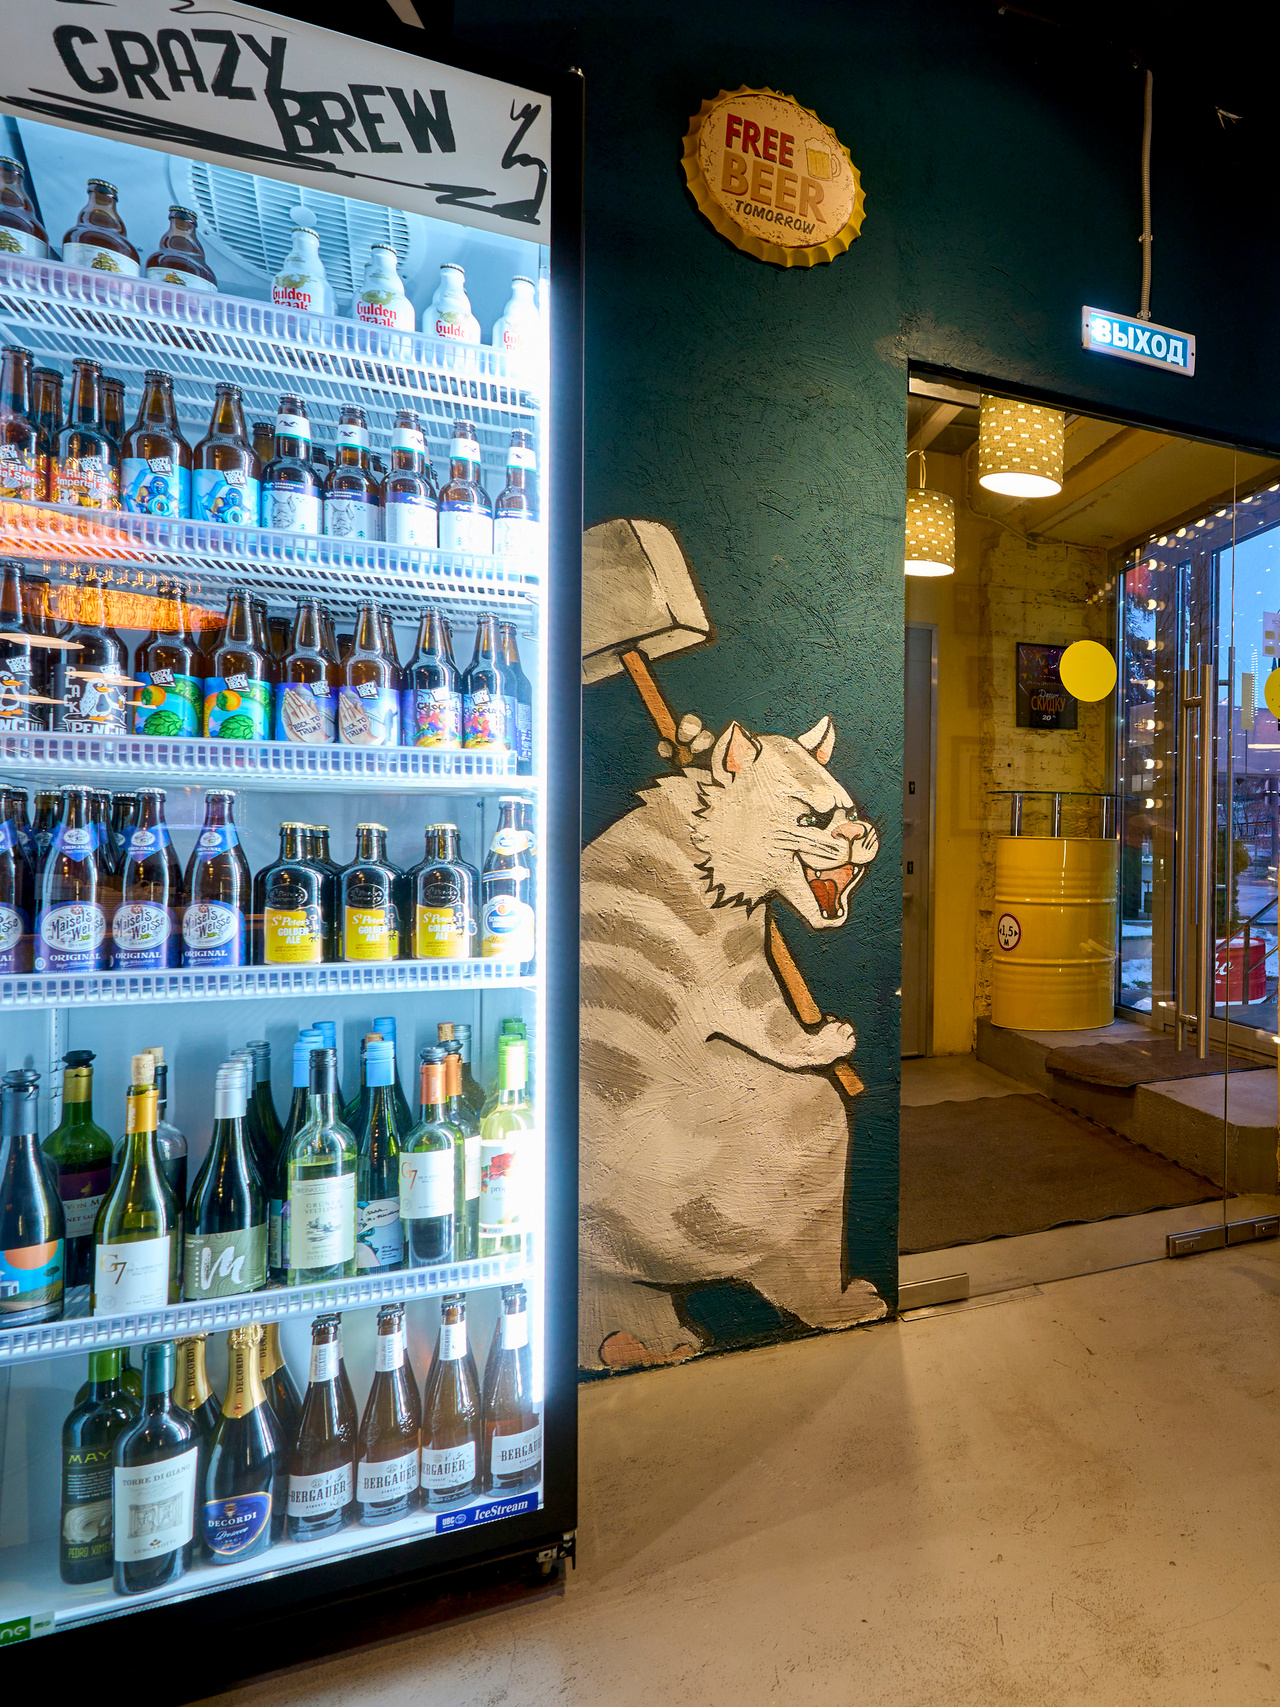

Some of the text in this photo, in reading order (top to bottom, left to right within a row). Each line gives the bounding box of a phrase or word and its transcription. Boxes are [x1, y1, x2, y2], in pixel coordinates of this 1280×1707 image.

[52, 24, 287, 101] CRAZY
[267, 84, 456, 155] BREW
[725, 113, 795, 169] FREE
[721, 150, 827, 224] BEER
[735, 199, 816, 235] TOMORROW
[273, 286, 311, 303] Gulden
[357, 301, 397, 320] Gulden
[1095, 318, 1184, 366] ВЫХОД
[1031, 696, 1066, 714] СКИДКУ
[48, 906, 93, 940] Maisel's
[71, 917, 104, 941] Weisse
[131, 916, 164, 940] Weisse
[199, 915, 231, 938] Weisse
[277, 927, 309, 936] GOLDEN
[358, 926, 388, 934] GOLDEN
[1002, 925, 1013, 938] 1,5
[286, 936, 301, 944] ALE
[435, 932, 448, 940] ALE
[50, 953, 101, 961] ORIGINAL
[115, 951, 162, 959] ORIGINAL
[184, 949, 228, 957] ORIGINAL
[187, 1347, 195, 1387] DECORDI
[122, 1463, 191, 1486] TORRE DI GIANO
[364, 1465, 417, 1489] BERGAUER
[421, 1459, 465, 1476] ERGAUER
[290, 1481, 346, 1503] BERGAUER
[208, 1511, 257, 1527] DECORDI
[474, 1501, 528, 1521] IceStream
